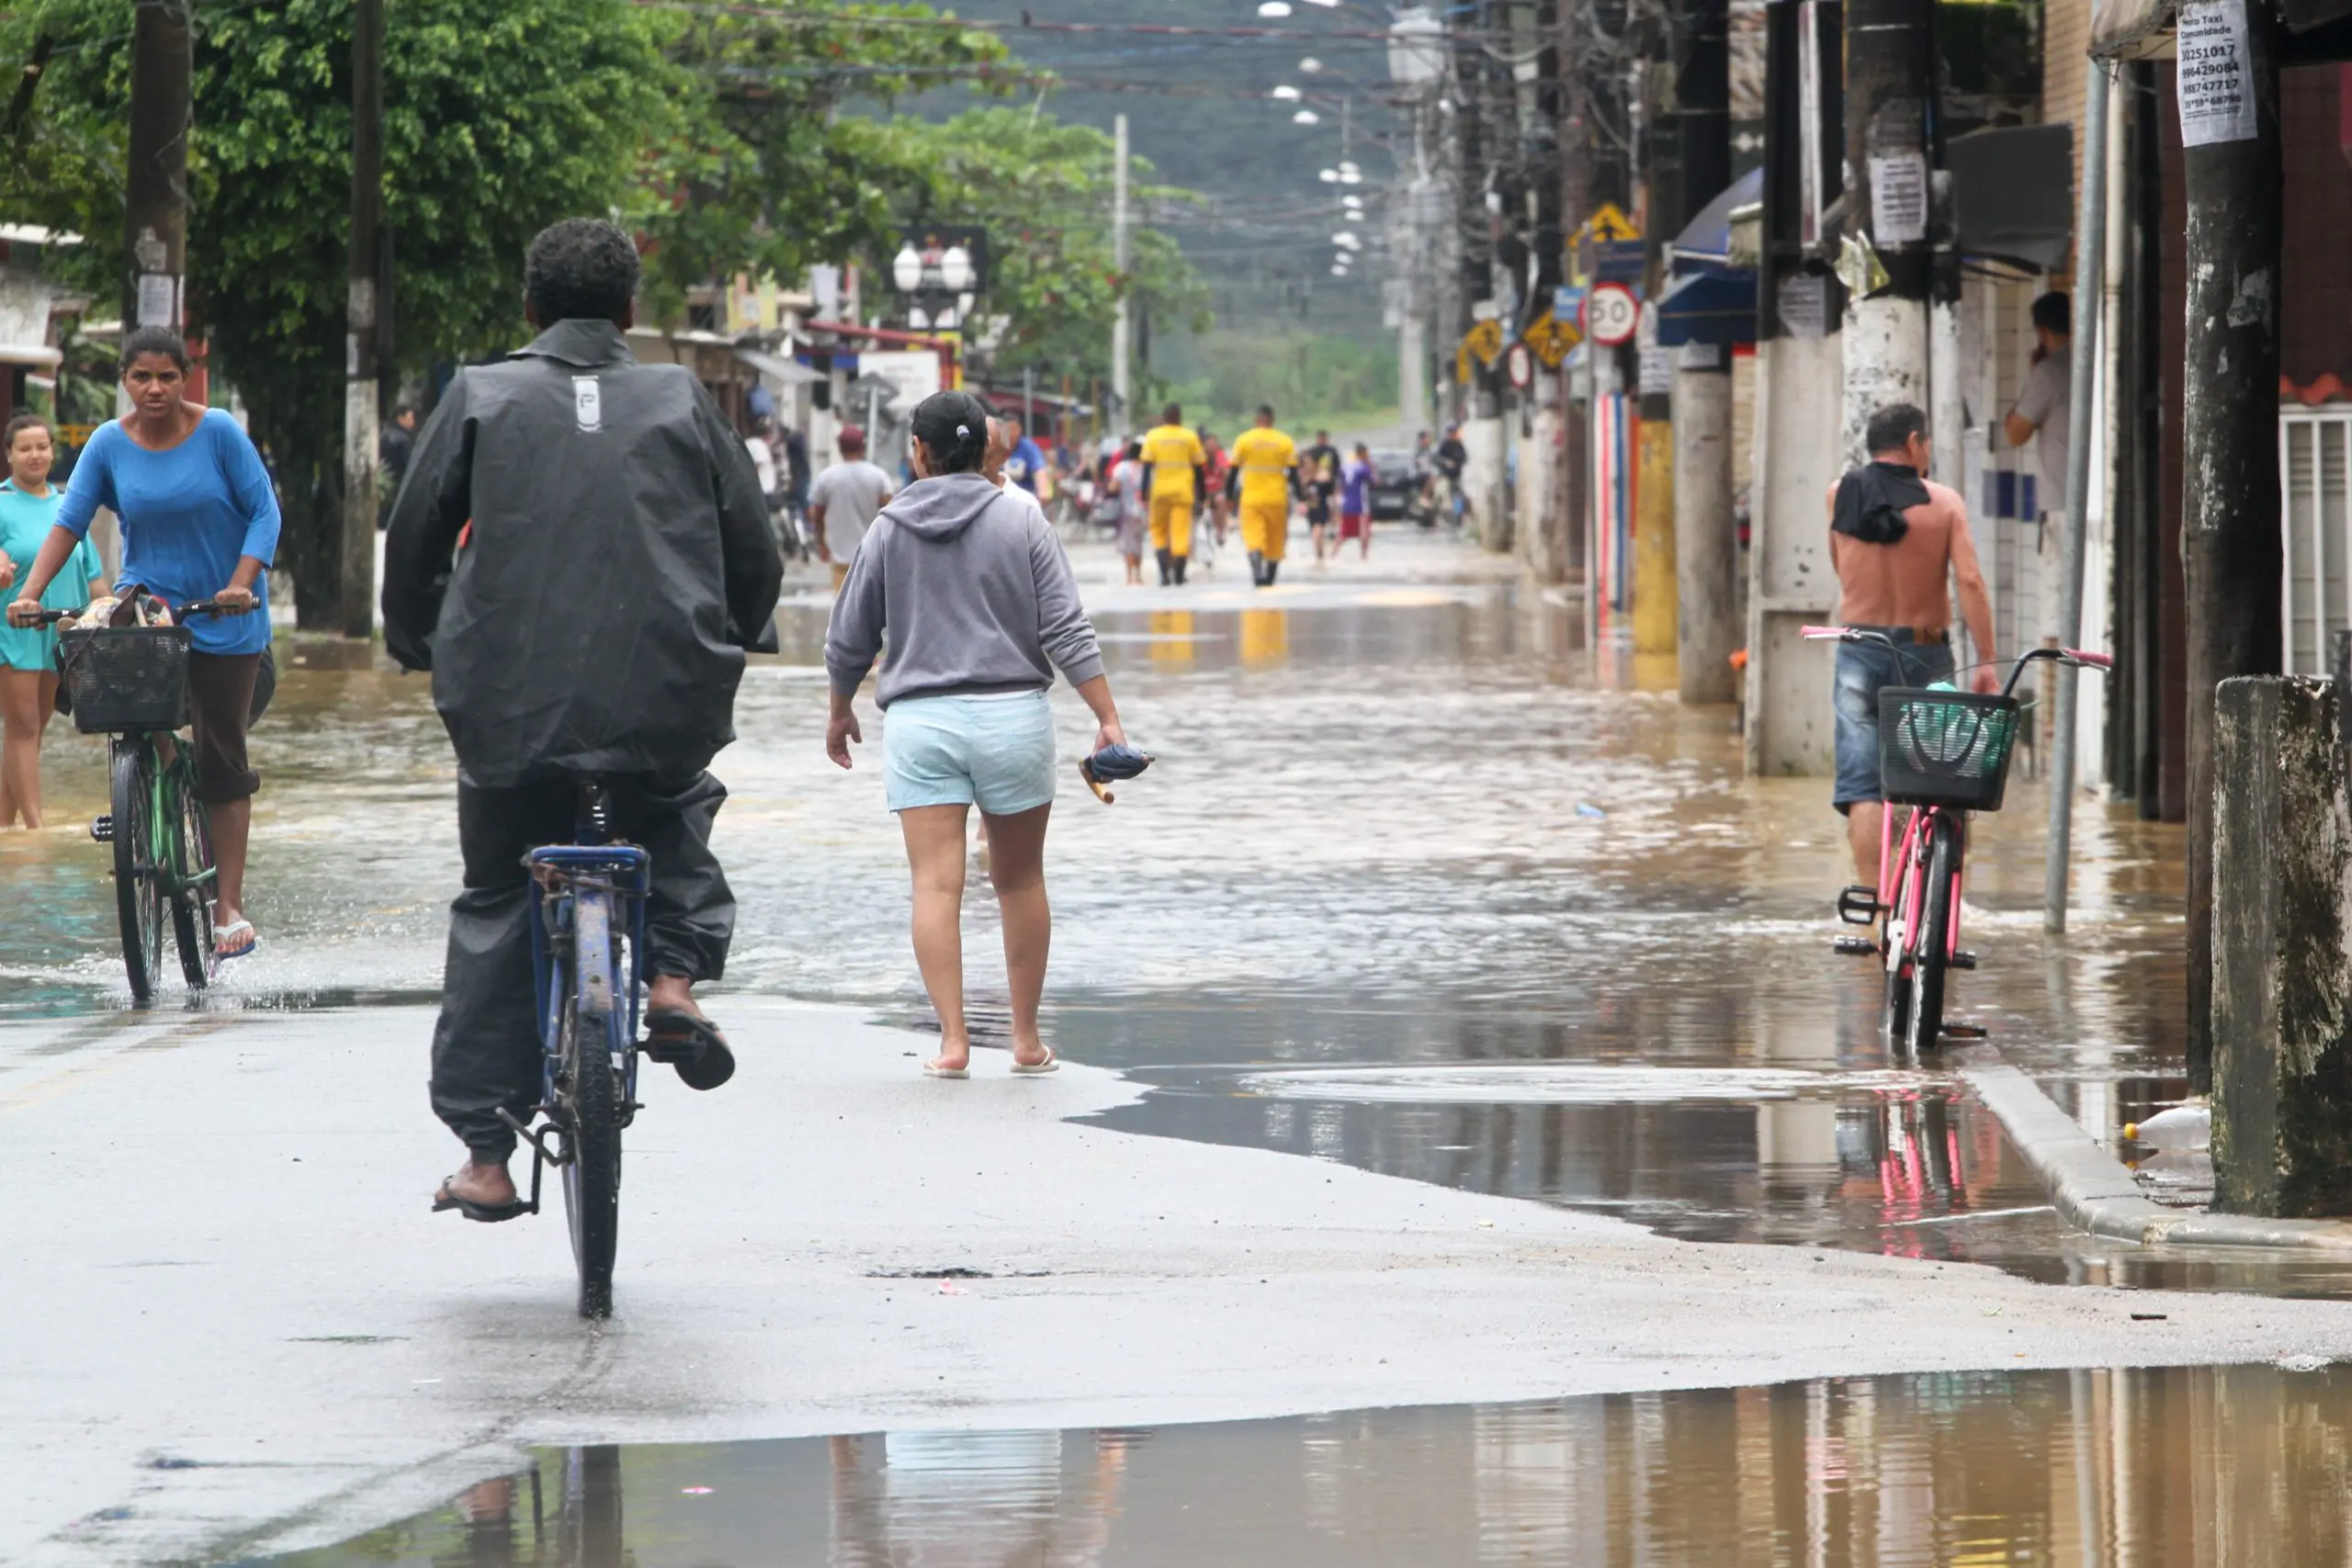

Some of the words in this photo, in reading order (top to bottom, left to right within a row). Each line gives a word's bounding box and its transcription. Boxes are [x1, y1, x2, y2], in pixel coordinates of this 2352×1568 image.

[2202, 15, 2222, 24] Taxi
[2181, 25, 2231, 39] Comunidade
[2181, 45, 2234, 62] 30251017
